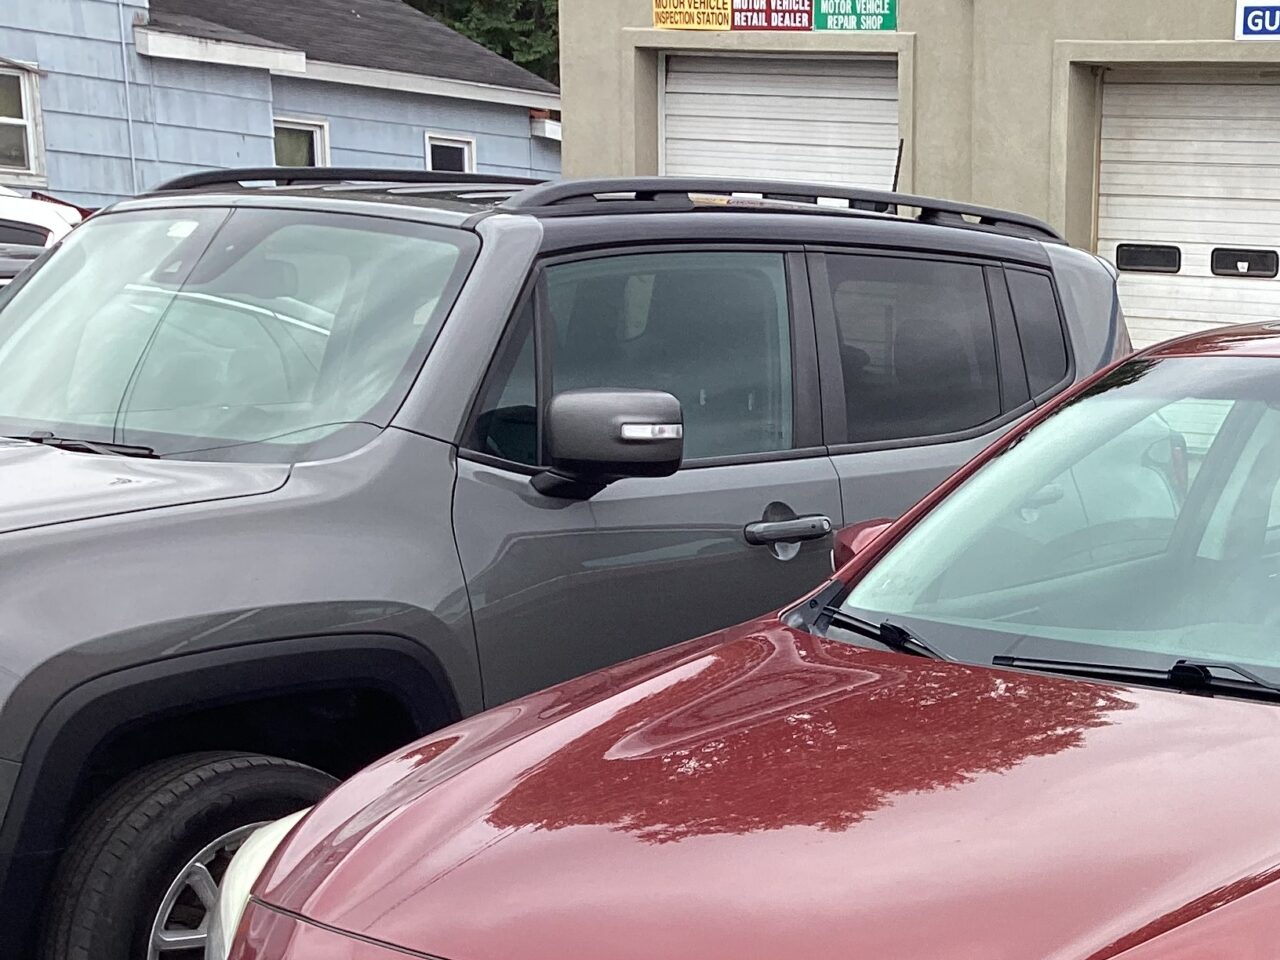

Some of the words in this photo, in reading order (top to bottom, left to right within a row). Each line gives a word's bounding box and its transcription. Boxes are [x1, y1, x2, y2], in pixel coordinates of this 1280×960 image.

[655, 0, 685, 9] MOTOR
[687, 0, 729, 10] VEHICLE
[733, 0, 767, 10] MOTOR
[770, 0, 811, 10] VEHICLE
[821, 0, 852, 14] MOTOR
[855, 0, 890, 14] VEHICLE
[655, 11, 695, 25] INSPECTION
[696, 12, 729, 26] STATION
[734, 12, 768, 26] RETAIL
[771, 12, 809, 27] DEALER
[827, 15, 857, 29] REPAIR
[860, 15, 884, 30] SHOP
